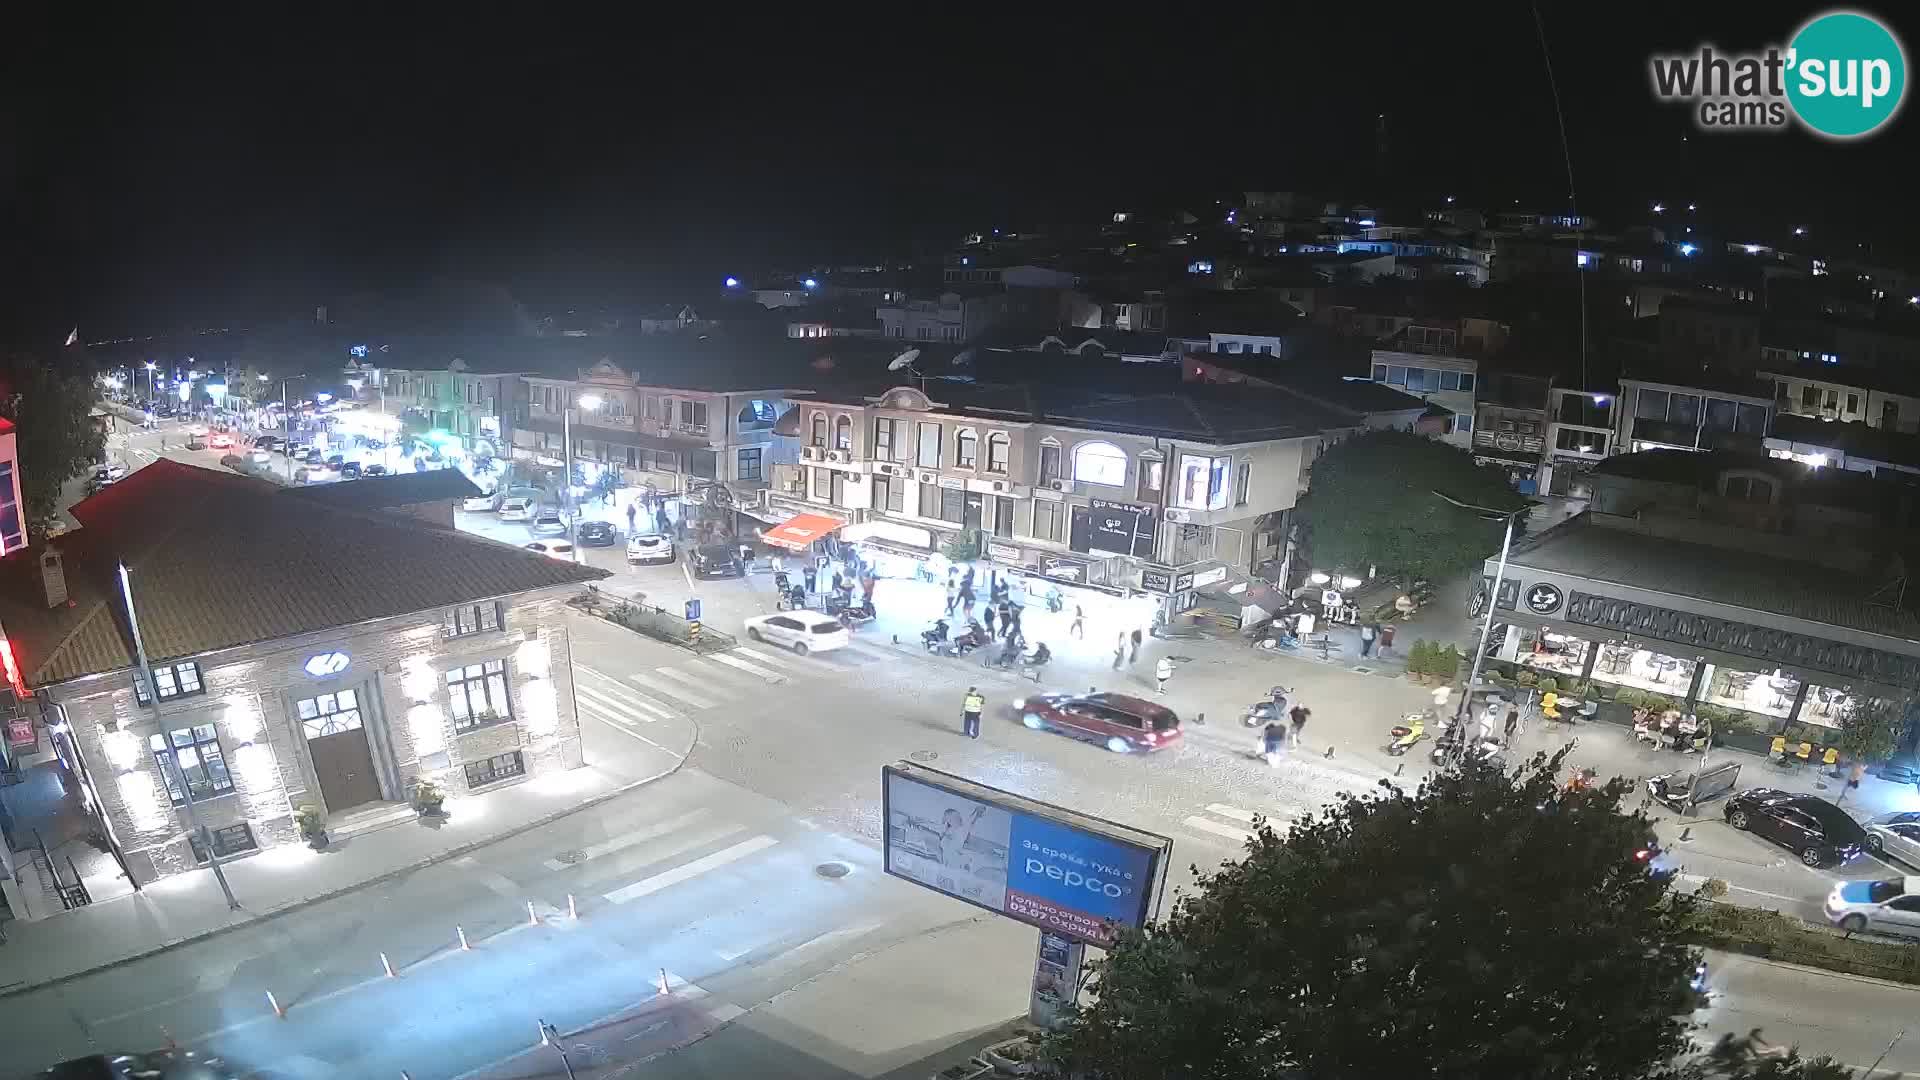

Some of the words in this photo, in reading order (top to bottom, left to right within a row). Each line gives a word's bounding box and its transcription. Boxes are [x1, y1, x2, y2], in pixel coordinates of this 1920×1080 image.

[1023, 840, 1039, 851] За
[1025, 857, 1122, 898] pepco
[1010, 902, 1047, 919] 02.07
[1050, 916, 1097, 939] Охрид
